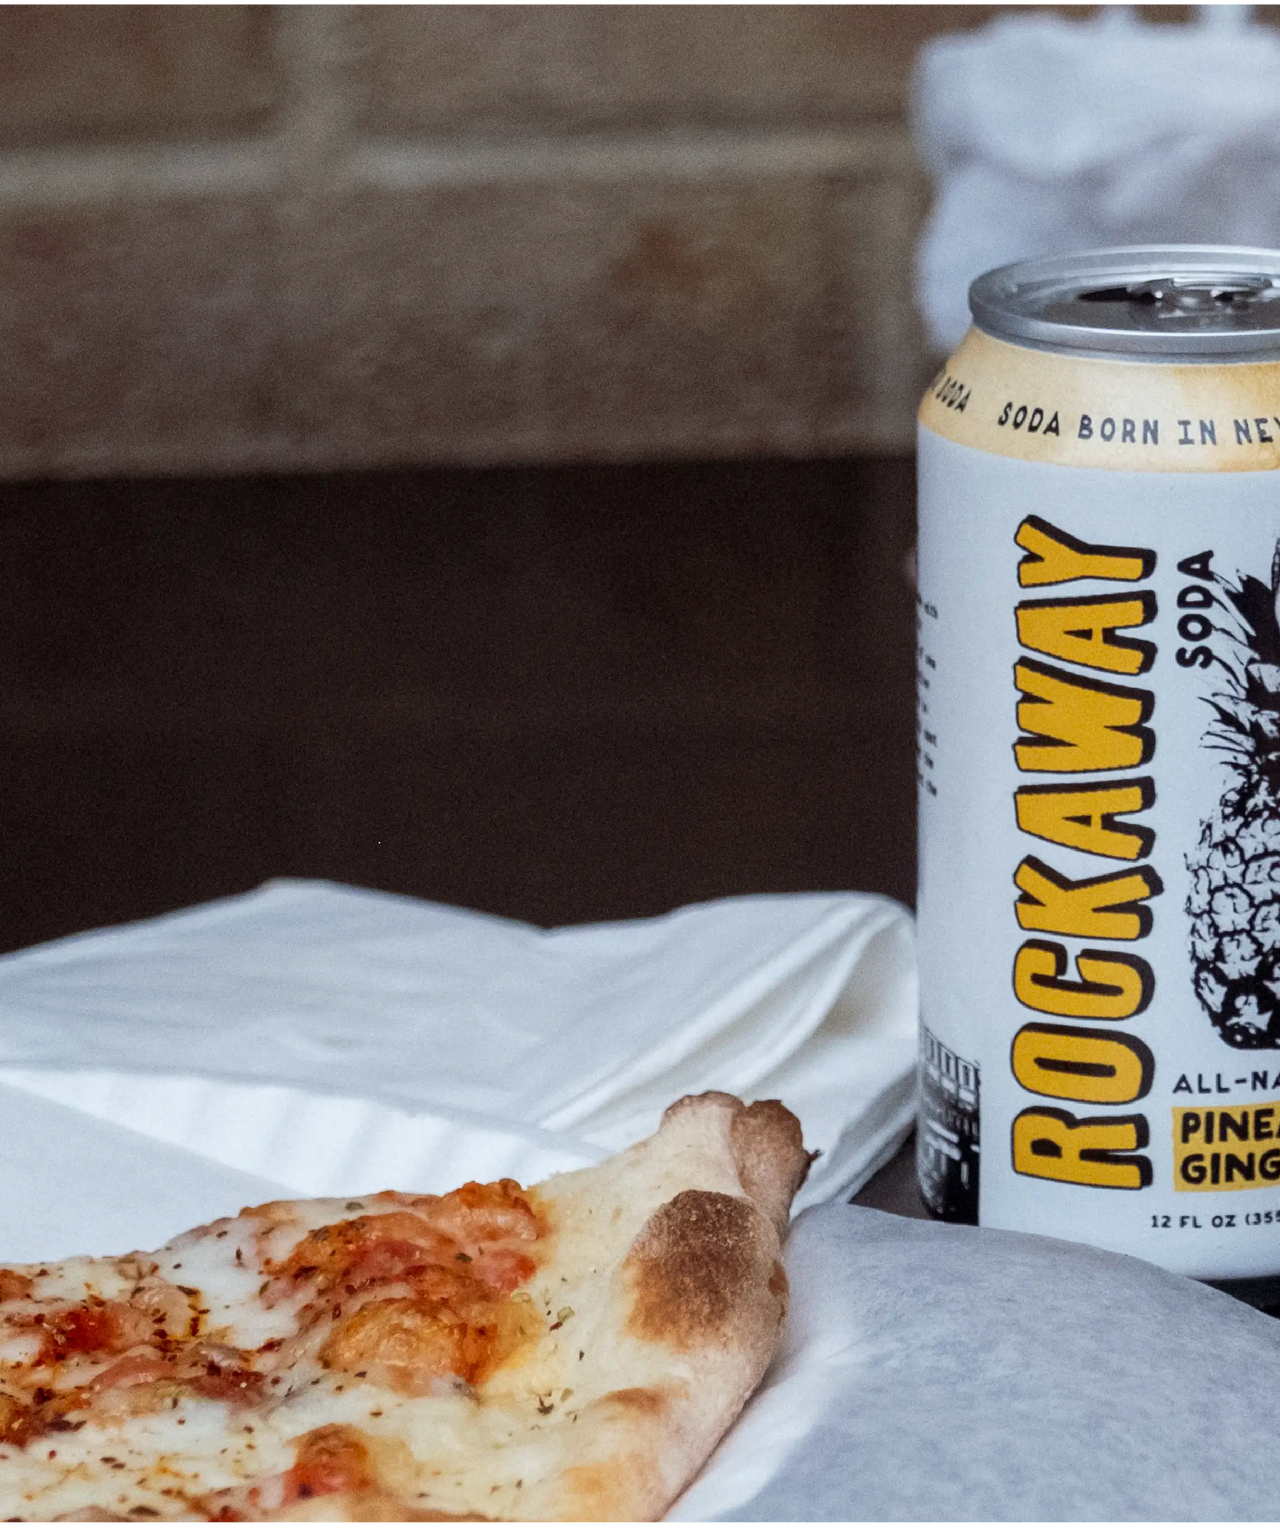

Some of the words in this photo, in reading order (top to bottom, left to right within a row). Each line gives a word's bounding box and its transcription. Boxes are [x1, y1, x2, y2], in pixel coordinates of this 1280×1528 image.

[997, 401, 1060, 437] SODA
[1077, 414, 1159, 446] BORN
[1177, 418, 1217, 446] IN
[1176, 550, 1215, 669] SODA
[1010, 513, 1164, 1190] ROCKAWAY
[1151, 1215, 1171, 1228] 12
[1179, 1216, 1202, 1228] FL
[1211, 1215, 1236, 1228] OZ
